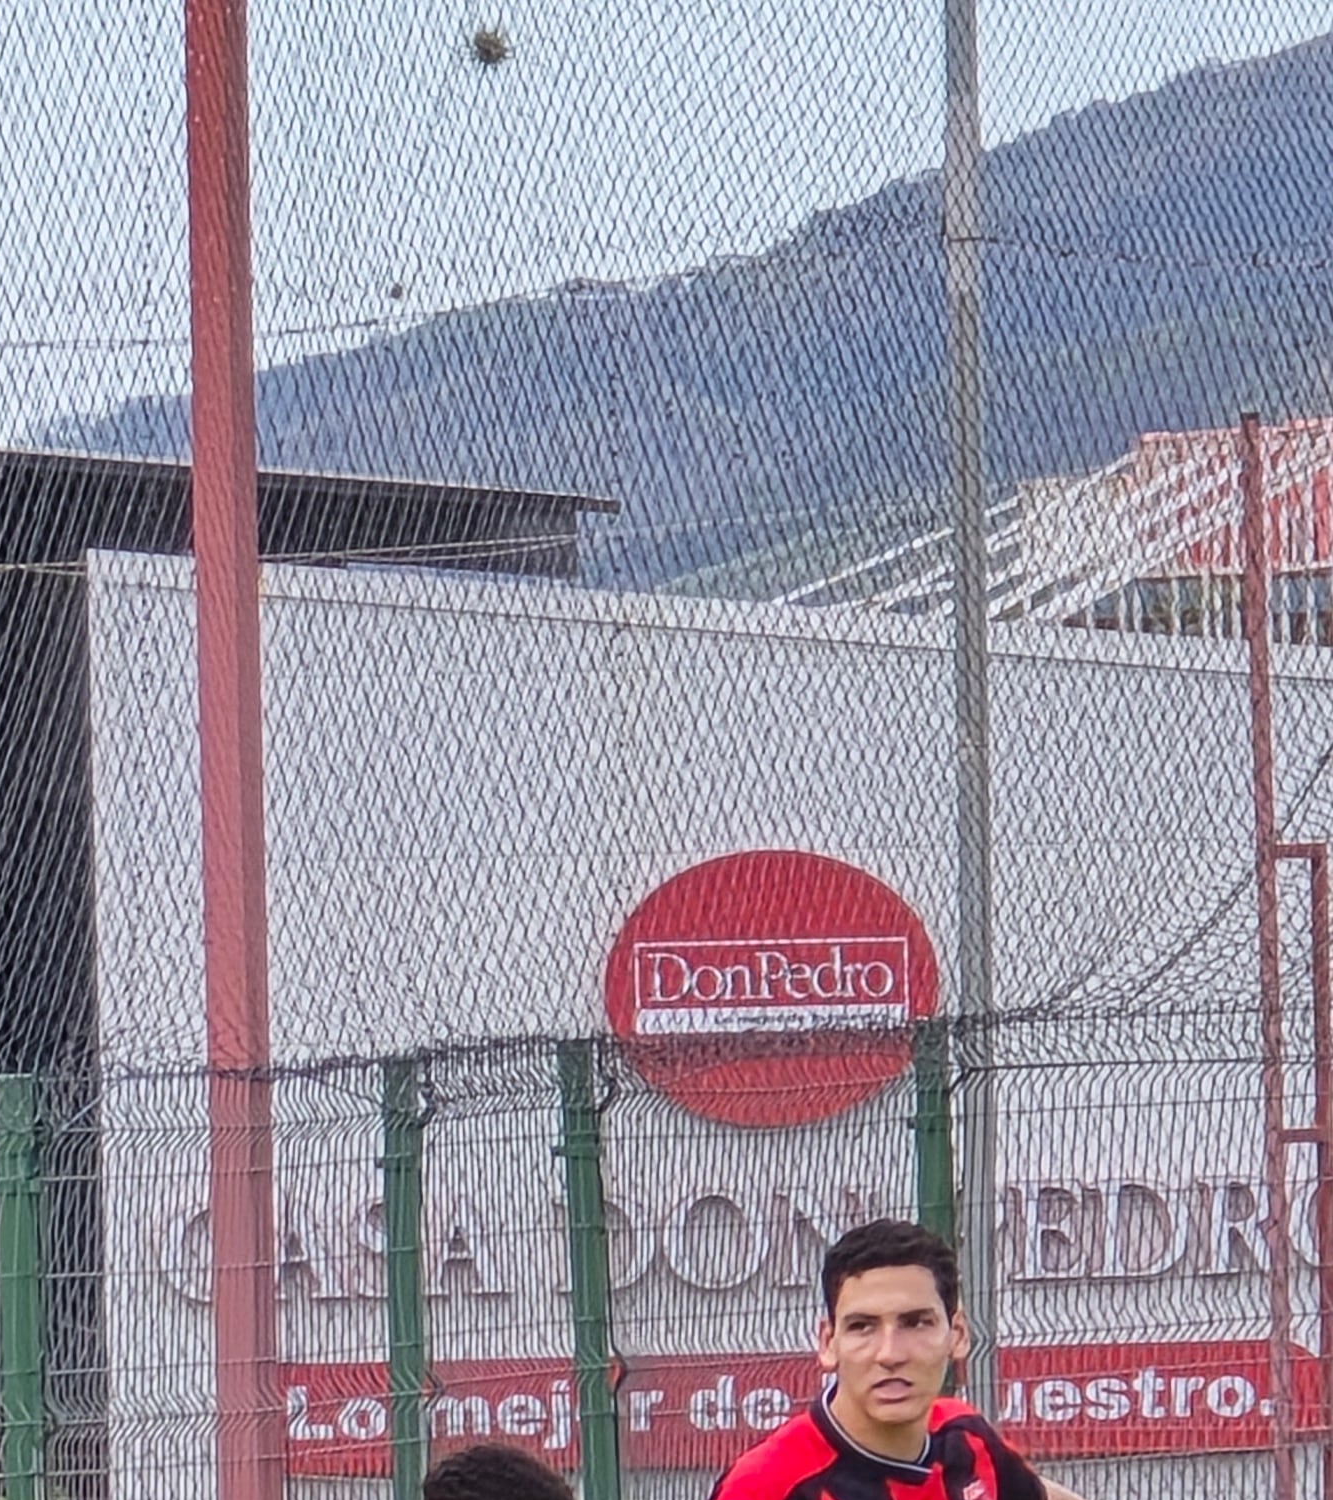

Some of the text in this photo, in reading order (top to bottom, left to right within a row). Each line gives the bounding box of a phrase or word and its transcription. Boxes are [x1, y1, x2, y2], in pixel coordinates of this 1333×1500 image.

[646, 945, 895, 1003] DonPedro
[287, 1384, 387, 1443] Lo
[427, 1376, 665, 1451] mejr
[688, 1374, 792, 1432] de
[998, 1366, 1276, 1420] uestro.
